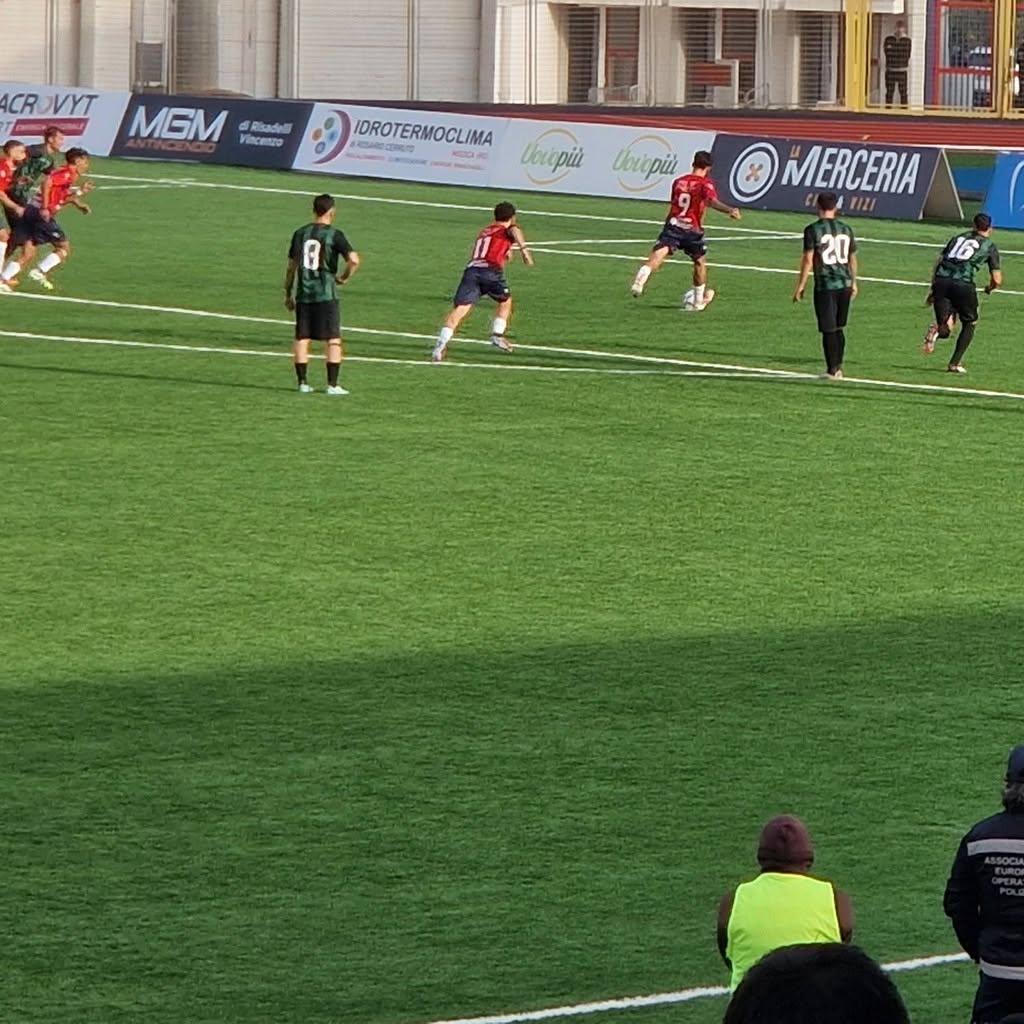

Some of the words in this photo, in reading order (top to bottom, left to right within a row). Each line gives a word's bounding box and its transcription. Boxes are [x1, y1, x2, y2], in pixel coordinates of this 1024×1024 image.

[128, 105, 229, 142] MGM
[354, 119, 493, 147] IDROTERMOCLIMA
[781, 145, 921, 195] MERCERIA
[678, 192, 691, 217] 9
[473, 236, 492, 259] 11
[821, 233, 850, 265] 20
[947, 236, 980, 260] 16
